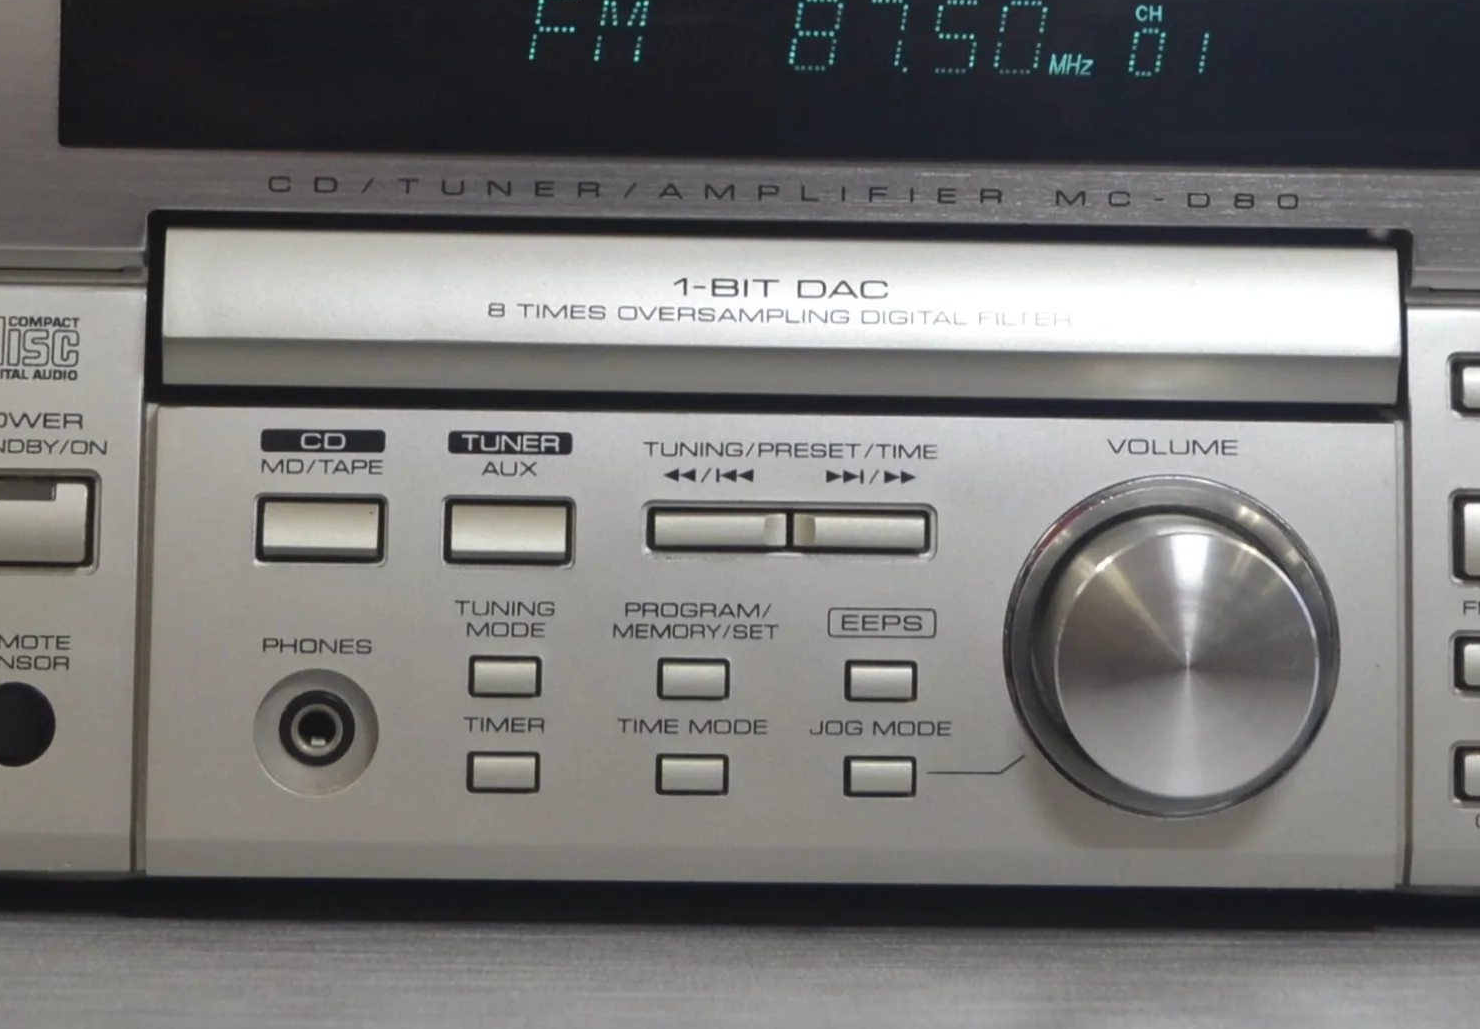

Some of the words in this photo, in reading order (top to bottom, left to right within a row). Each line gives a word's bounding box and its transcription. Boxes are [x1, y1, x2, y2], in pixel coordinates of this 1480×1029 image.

[1135, 4, 1163, 23] CH
[1128, 27, 1209, 77] 01
[1048, 54, 1094, 76] MHz
[1055, 189, 1300, 211] MC-D80
[673, 277, 780, 299] 1-BIT
[796, 279, 889, 300] DAC
[8, 315, 80, 329] COMPACT
[487, 303, 506, 318] 8
[516, 303, 606, 321] TIMES
[617, 305, 850, 325] OVERSAMPLING
[860, 308, 967, 327] DIGITAL
[977, 310, 1073, 328] FILTER
[31, 369, 78, 381] AUDIO
[300, 432, 347, 451] CD
[461, 433, 561, 453] TUNER
[1107, 438, 1239, 457] VOLUME
[261, 458, 383, 476] MD/TAPE
[482, 461, 538, 477] AUX
[455, 600, 556, 617] TUNING
[625, 602, 772, 620] PROGRAM/
[466, 621, 546, 638] MODE
[612, 623, 779, 641] MEMORY/SET
[840, 614, 923, 633] EEPS
[262, 637, 373, 655] PHONES
[464, 716, 546, 734] TIMER
[617, 718, 680, 735] TIME
[688, 718, 769, 736] MODE
[809, 719, 864, 737] JOG
[873, 720, 953, 738] MODE
